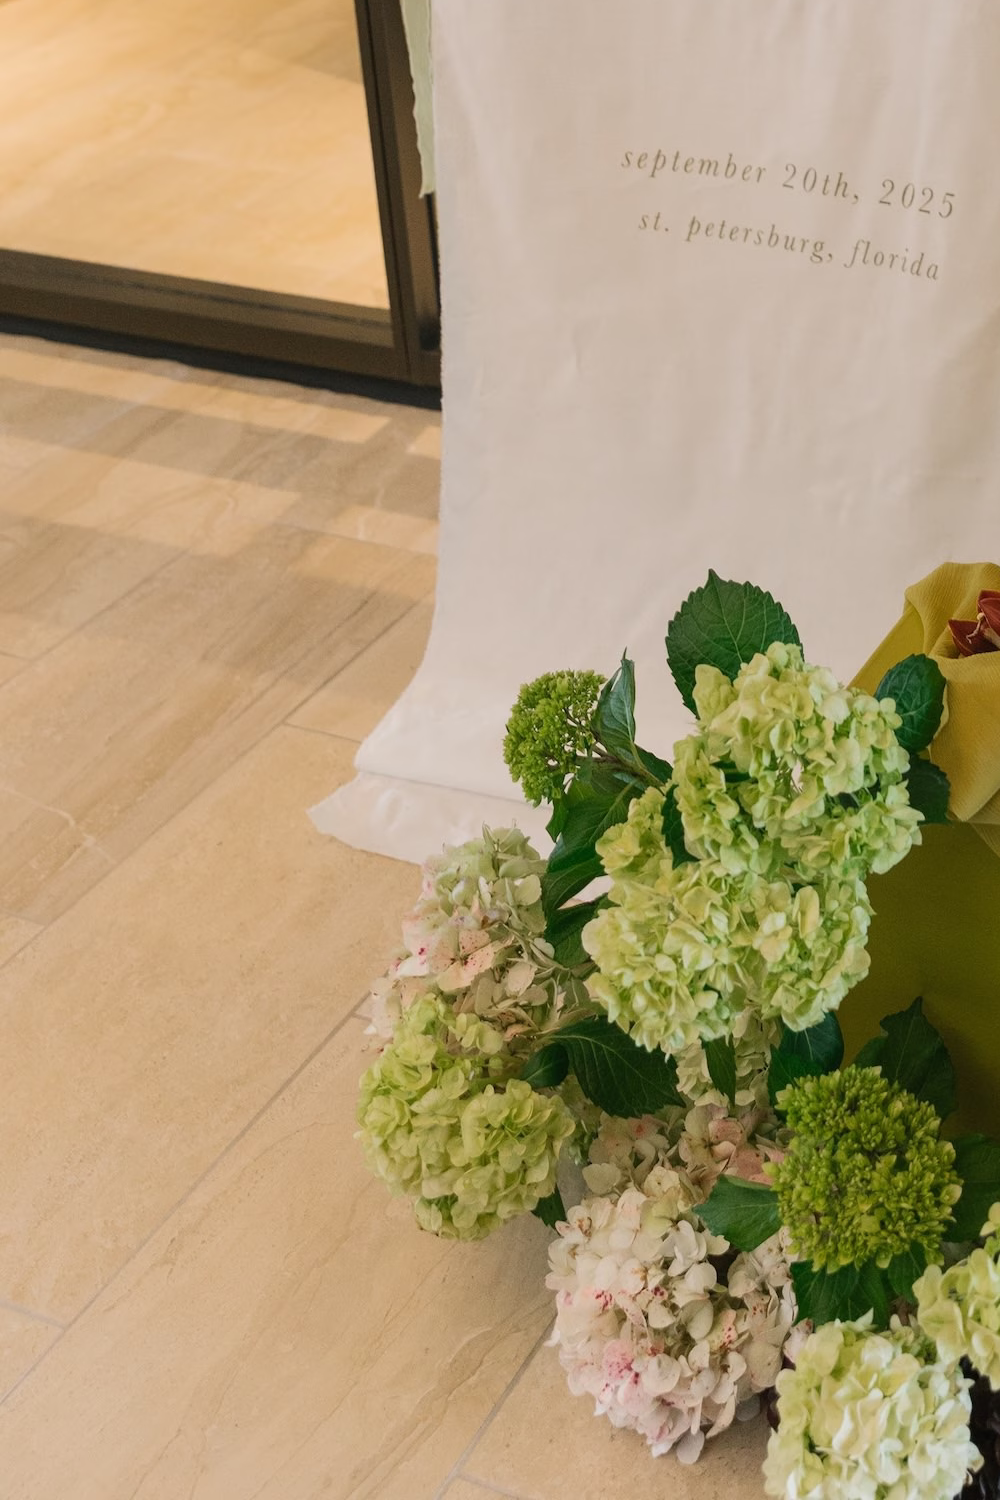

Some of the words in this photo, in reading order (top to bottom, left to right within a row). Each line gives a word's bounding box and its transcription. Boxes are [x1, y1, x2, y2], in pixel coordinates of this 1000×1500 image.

[620, 147, 768, 184] september
[781, 163, 861, 204] 20th,
[877, 179, 957, 220] 2025
[638, 211, 670, 233] st.
[683, 214, 834, 263] petersburg,
[843, 239, 940, 281] florida
